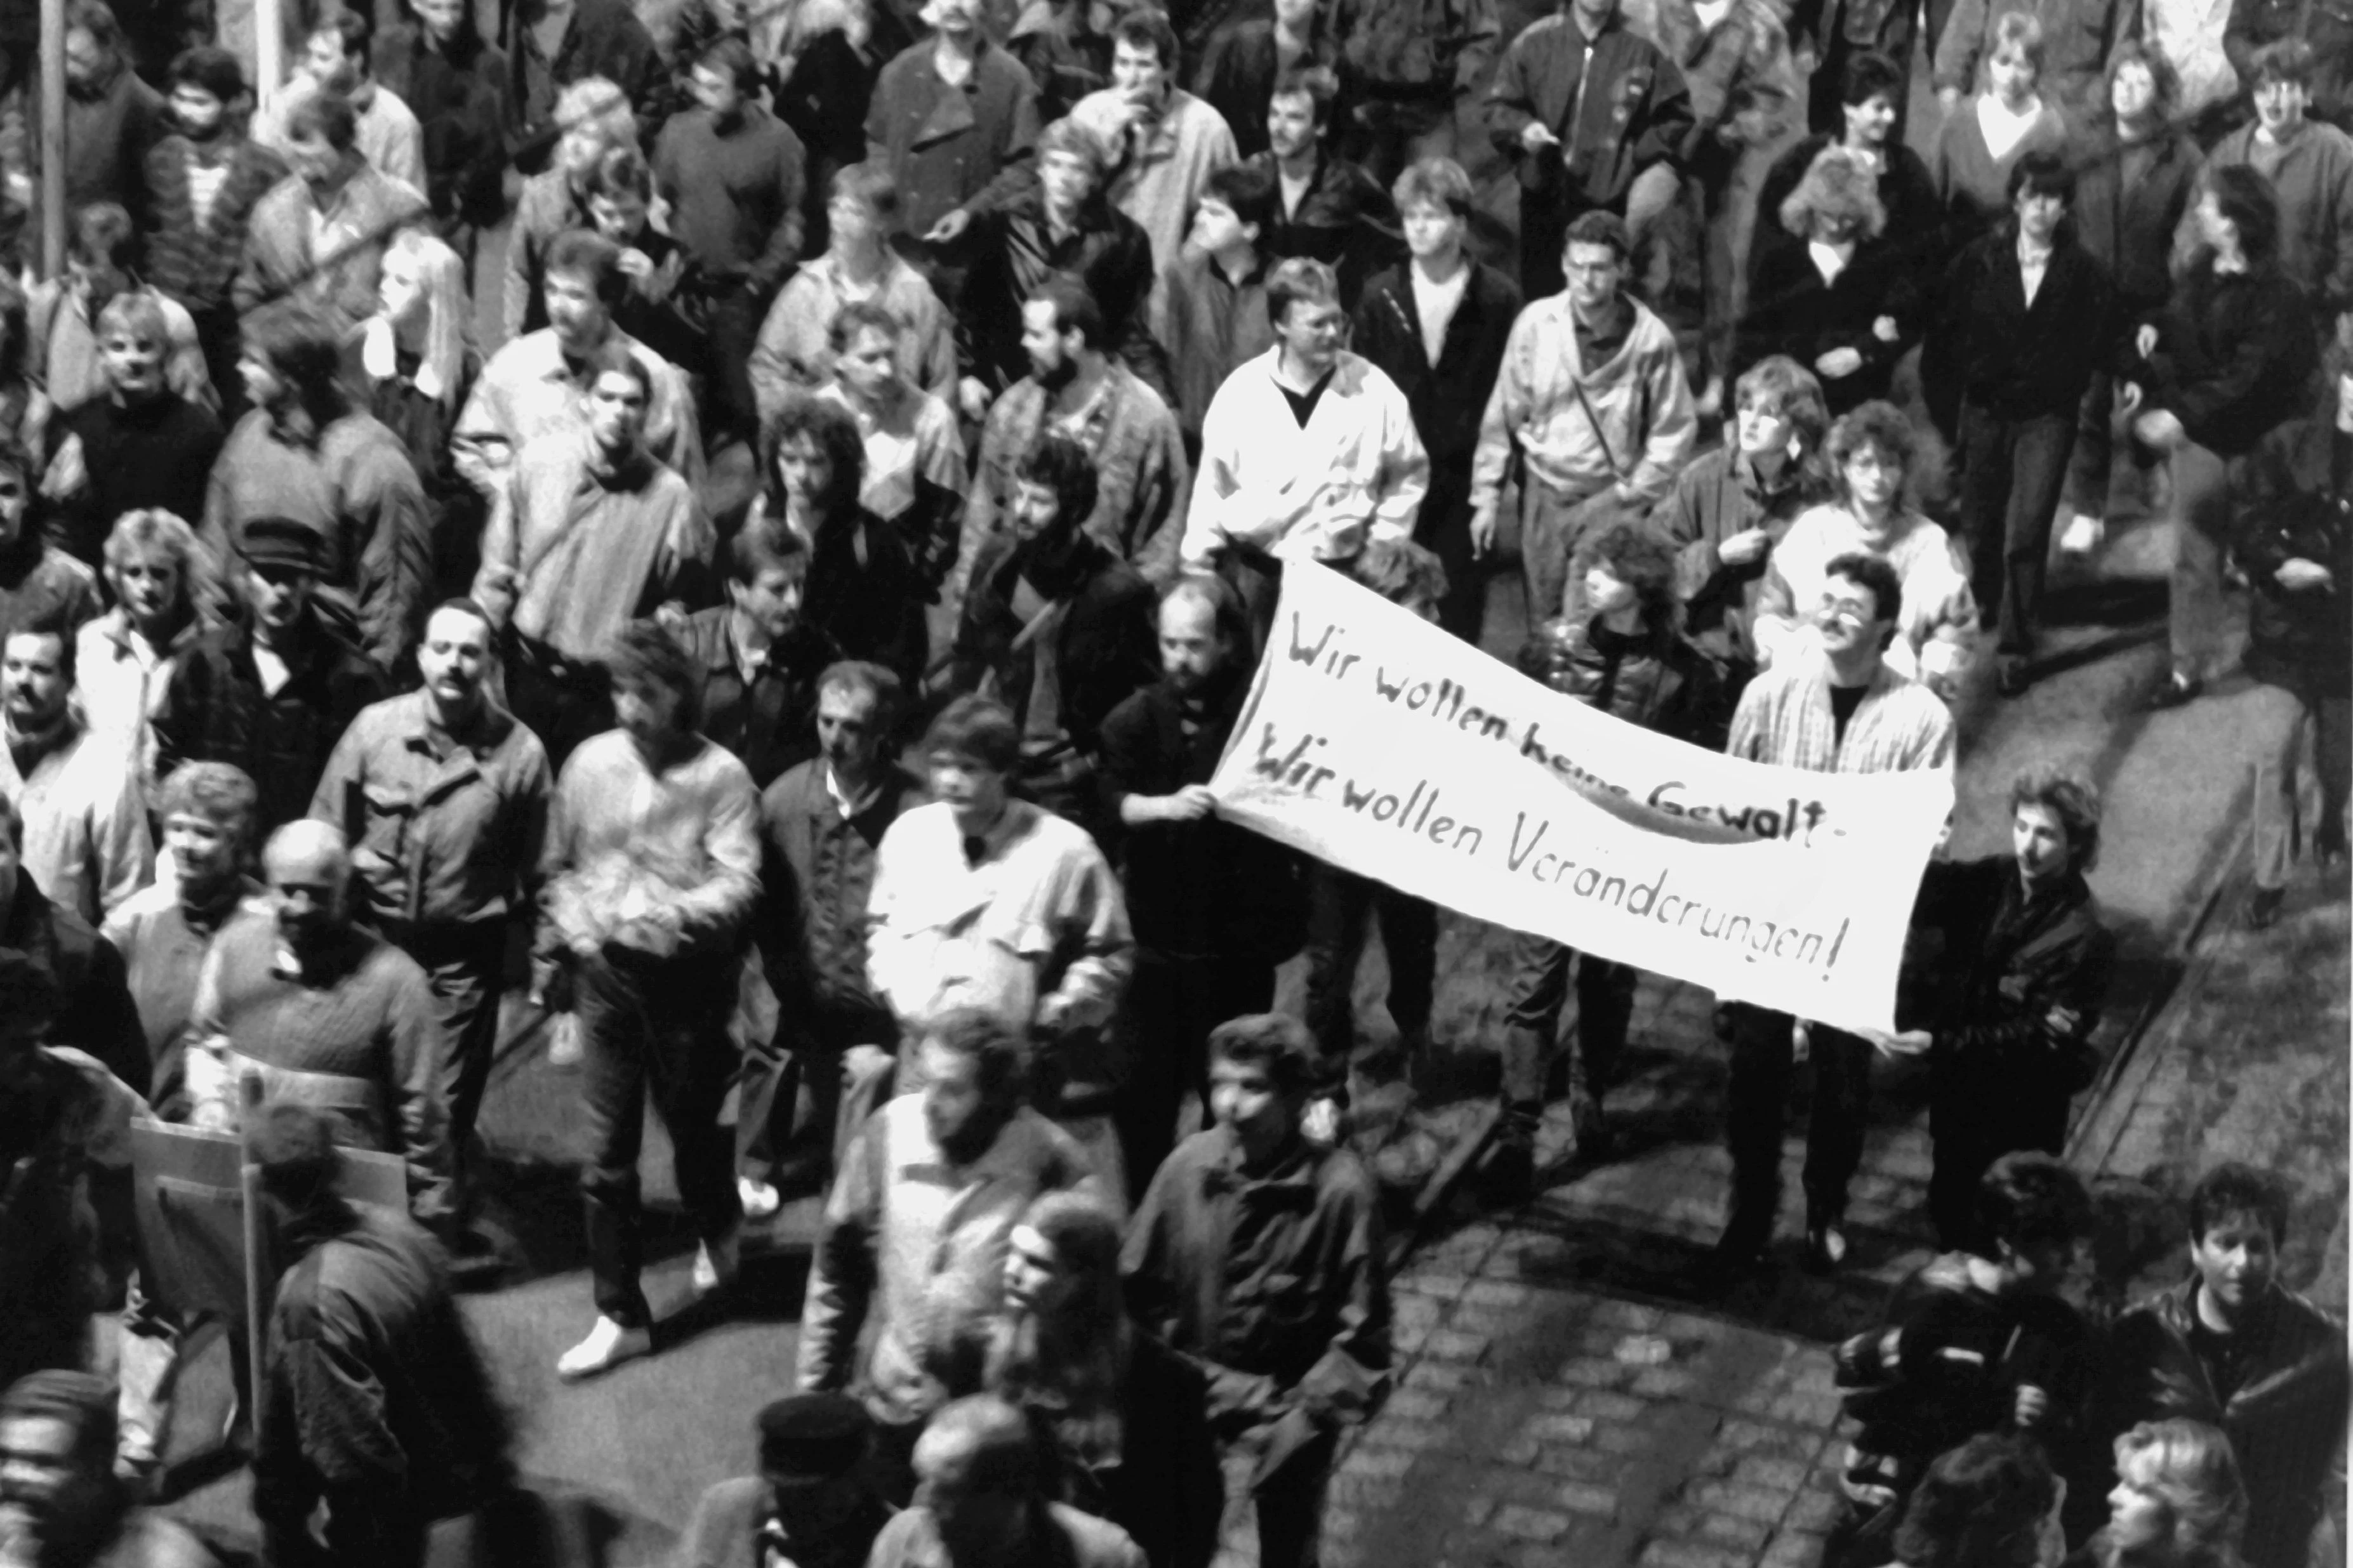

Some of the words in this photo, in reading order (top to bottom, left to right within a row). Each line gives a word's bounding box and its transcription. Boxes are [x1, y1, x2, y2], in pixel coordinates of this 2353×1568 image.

[1289, 610, 1362, 680] Wir
[1375, 666, 1509, 742] wollen
[1254, 721, 1336, 793] Wir
[1342, 779, 1483, 856] wollen
[1507, 810, 1850, 982] Veränderungen!
